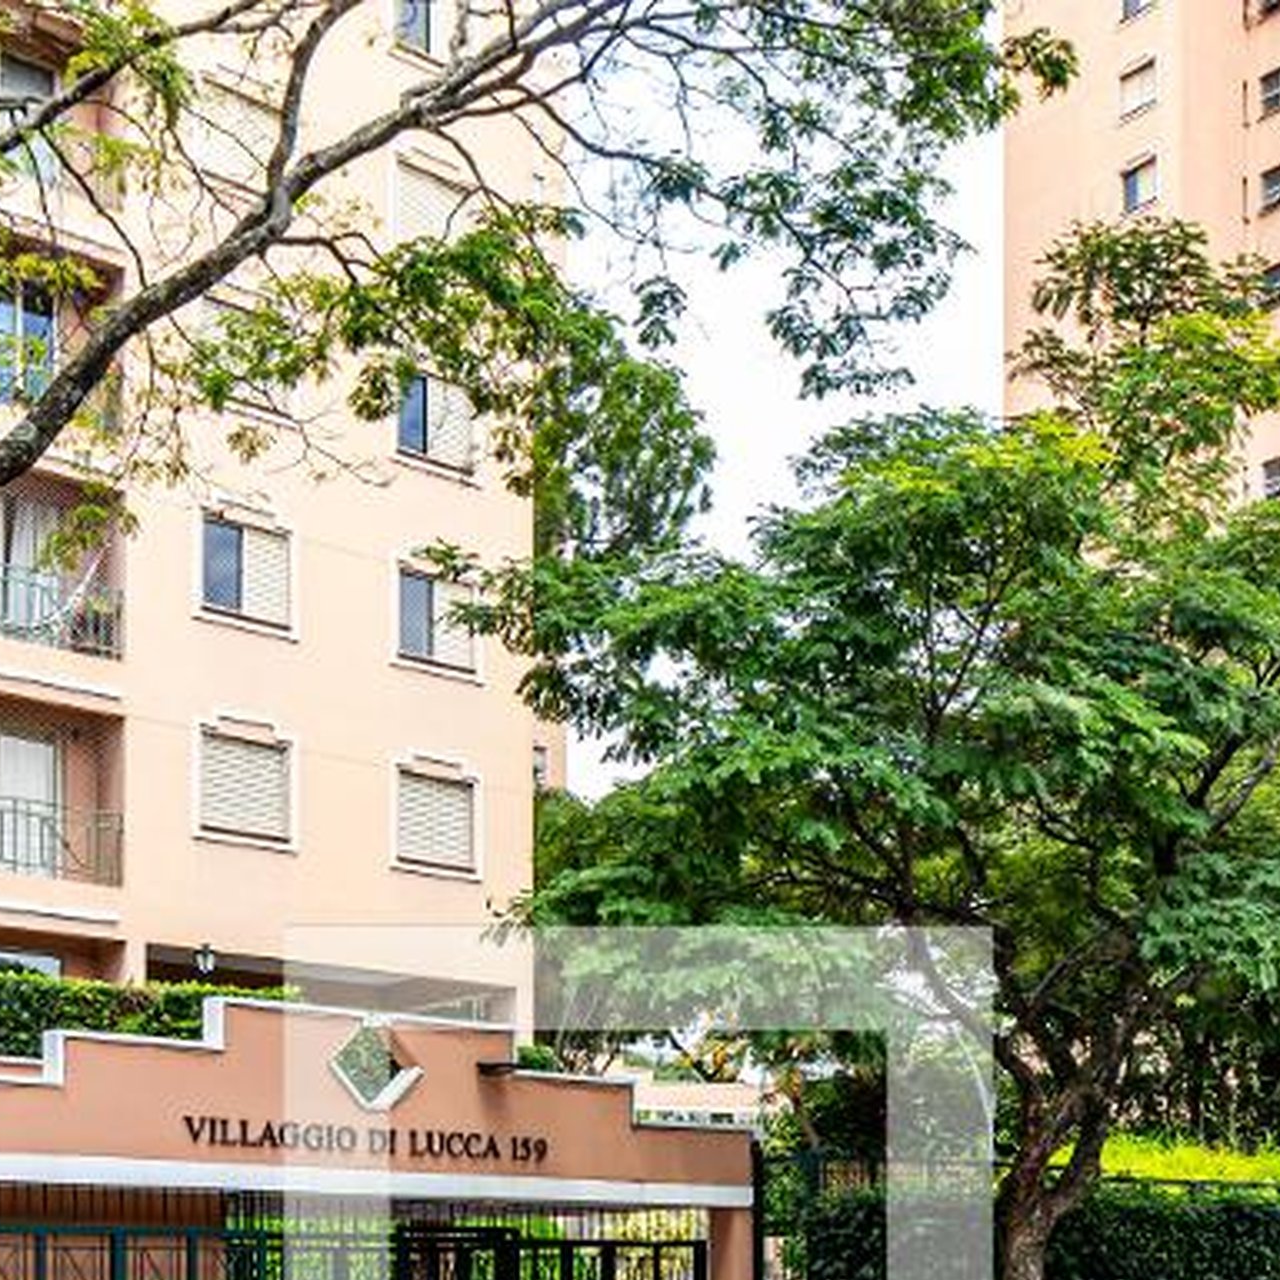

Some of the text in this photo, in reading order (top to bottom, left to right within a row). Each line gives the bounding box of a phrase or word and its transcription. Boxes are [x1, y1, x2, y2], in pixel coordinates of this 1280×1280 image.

[183, 1115, 549, 1164] VILLAGGIO DI LUCCA 159
